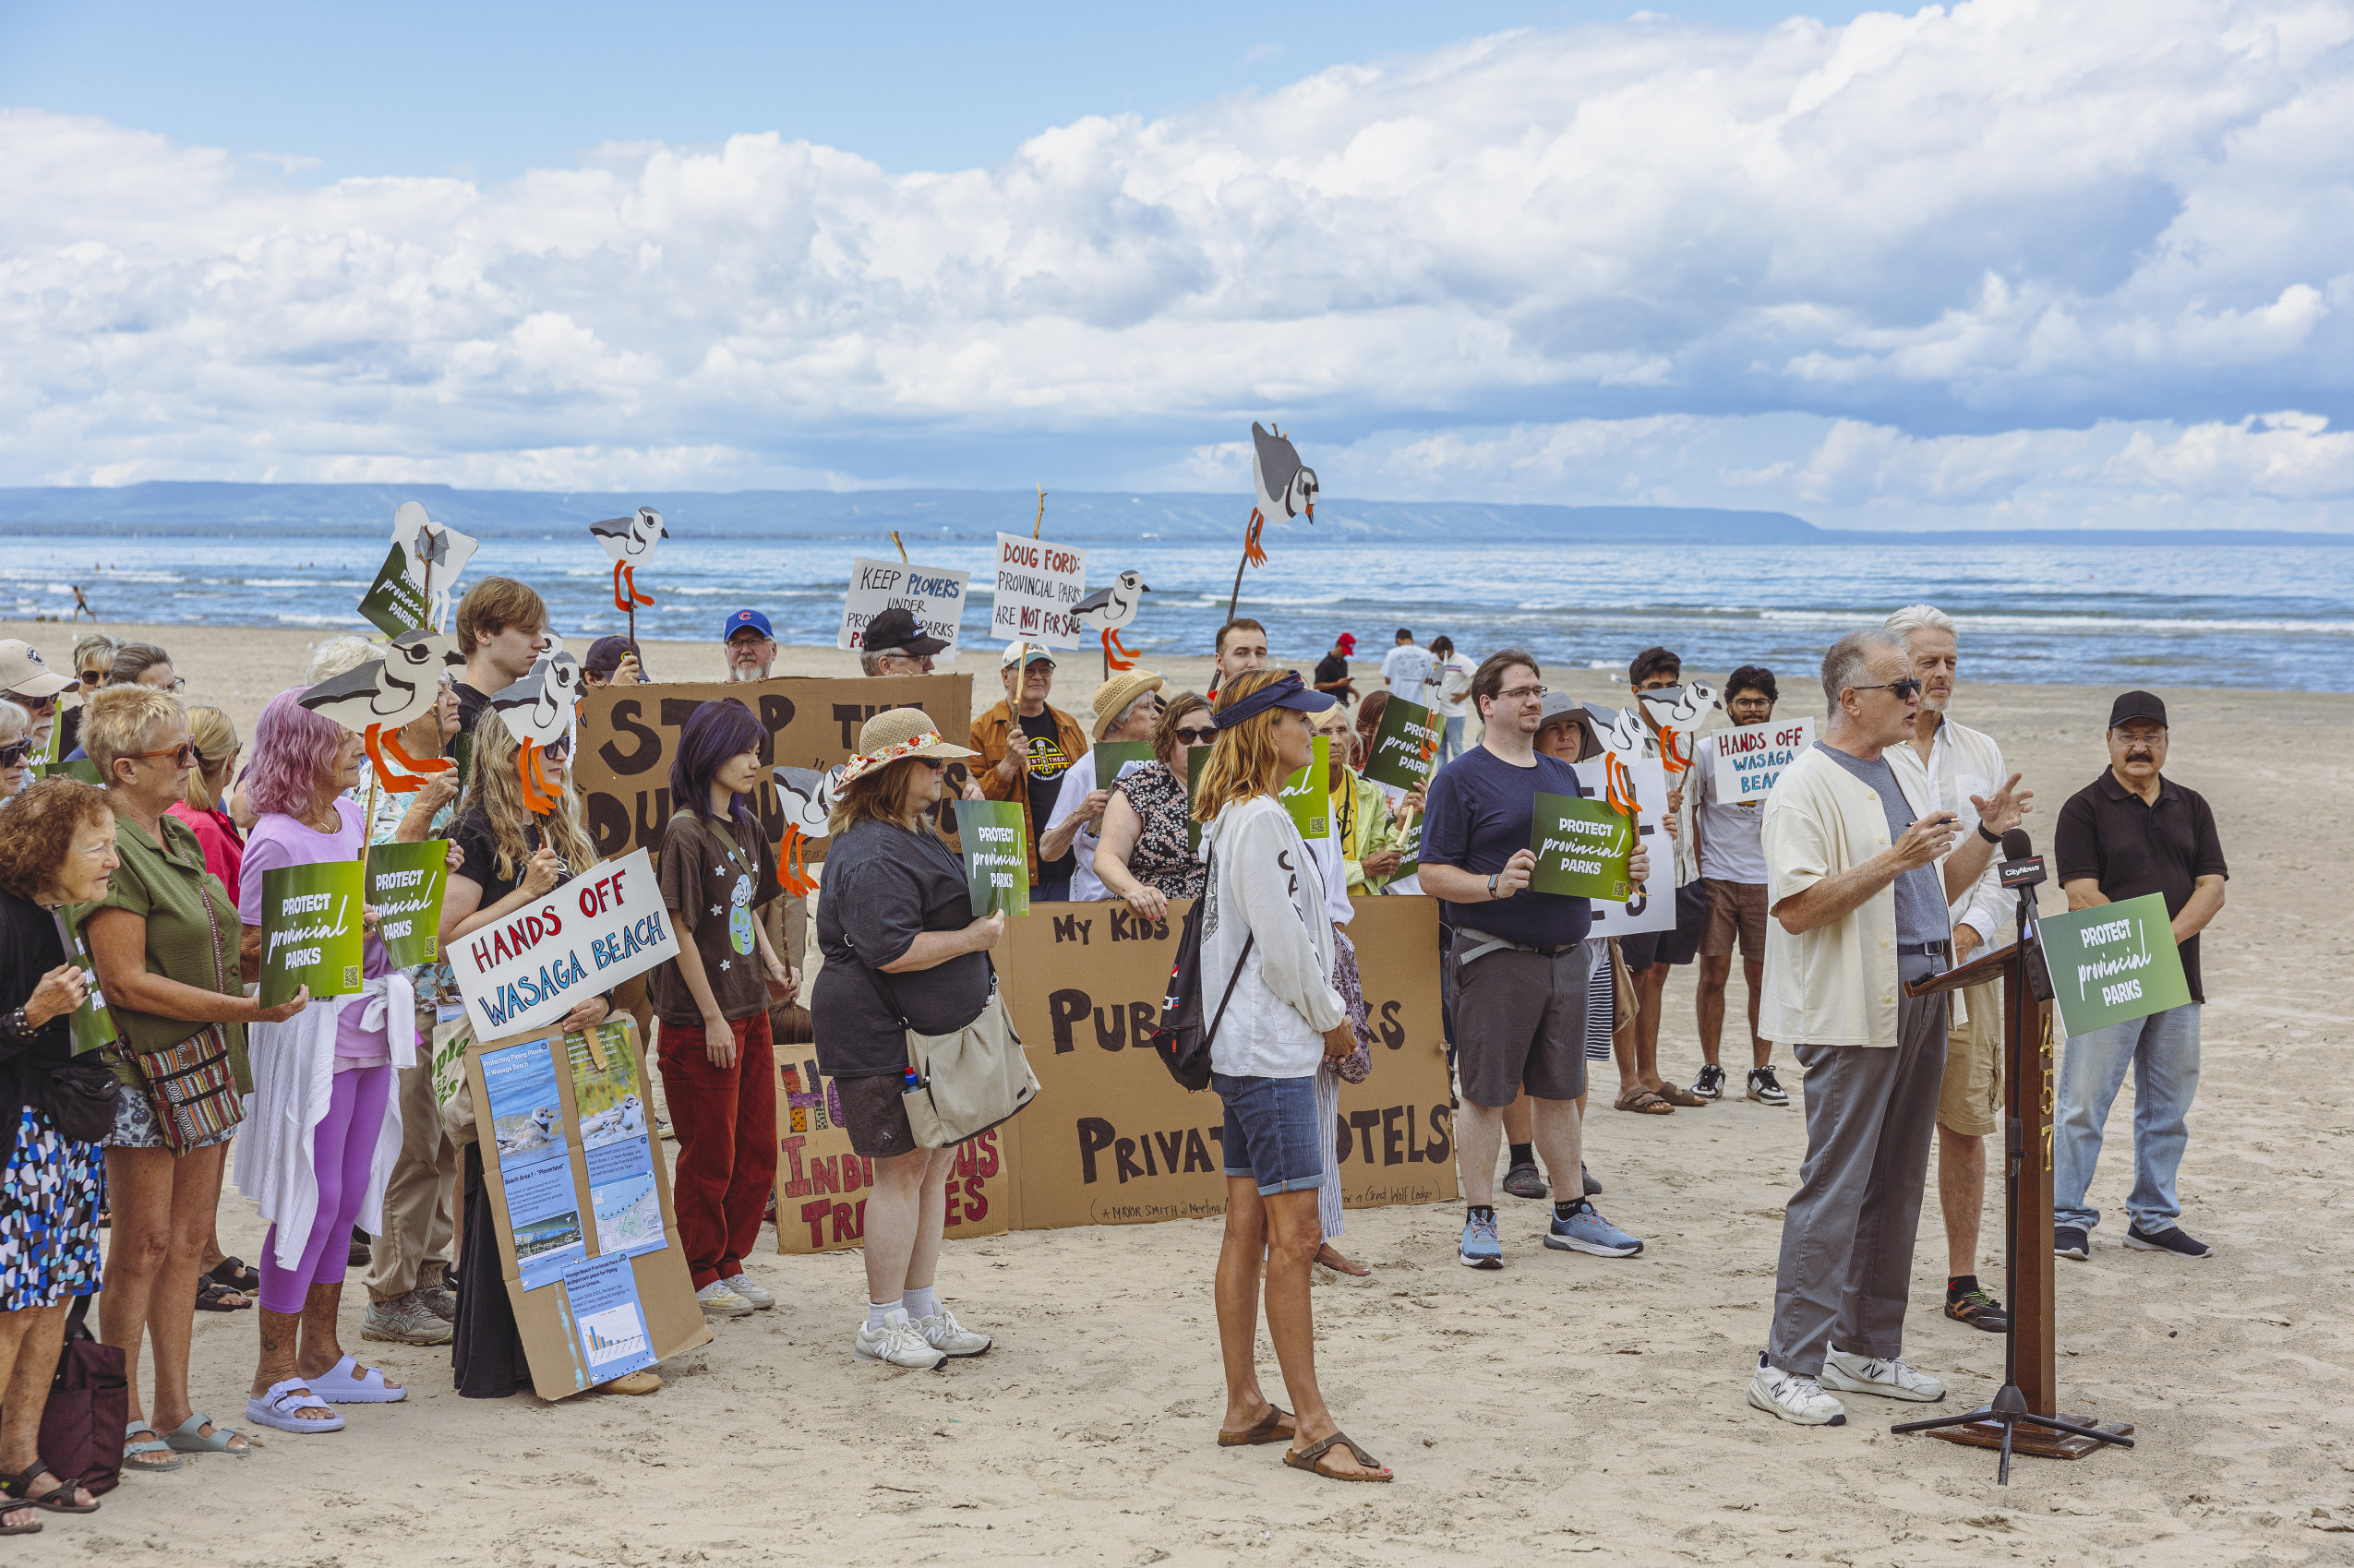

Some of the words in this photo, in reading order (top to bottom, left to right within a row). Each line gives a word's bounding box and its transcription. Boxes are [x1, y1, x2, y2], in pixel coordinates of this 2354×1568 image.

[1003, 543, 1039, 568] DOUG
[1045, 549, 1080, 574] FORD:
[860, 567, 901, 590] KEEP
[906, 573, 960, 598] PLOVERS
[998, 571, 1055, 598] PROVINCIAL
[1058, 582, 1082, 604] PARKS
[389, 601, 419, 629] PARKS
[739, 611, 751, 620] C
[887, 597, 926, 613] UNDER
[920, 619, 955, 638] PARKS
[995, 605, 1016, 625] ARE
[1020, 605, 1041, 629] NOT
[1043, 612, 1060, 633] FOR
[1061, 614, 1081, 637] SALE
[598, 694, 796, 776] STP
[1718, 732, 1767, 757] HANDS
[1775, 726, 1803, 747] OFF
[1732, 749, 1795, 772] WASAGA
[1740, 772, 1780, 794] BEAC
[978, 826, 1014, 843] PROTECT
[1558, 818, 1614, 838] PROTECT
[972, 831, 1023, 879] provincial
[1538, 828, 1627, 861] provincial
[1560, 857, 1602, 875] PARKS
[2004, 864, 2040, 877] CityNews
[375, 869, 425, 892] PROTECT
[990, 872, 1014, 888] PARKS
[282, 892, 332, 917] PROTECT
[267, 893, 349, 965] provincial
[383, 919, 413, 941] PARKS
[471, 905, 562, 974] HANDS
[579, 868, 626, 918] OFF
[1110, 907, 1171, 942] KIDS
[2080, 918, 2132, 949] PROTECT
[284, 947, 322, 971] PARKS
[477, 950, 589, 1027] WASAGA
[591, 911, 667, 971] BEACH
[2077, 918, 2152, 1002] provincial
[2101, 978, 2143, 1007] PARKS
[1048, 988, 1159, 1056] PUB
[483, 1056, 511, 1068] Protecting
[510, 1051, 528, 1061] Piping
[490, 1066, 512, 1077] Wasaga
[511, 1061, 529, 1071] Beach
[1076, 1117, 1225, 1185] PRIVAT
[1337, 1104, 1451, 1167] OTELS
[504, 1177, 520, 1186] Beach
[519, 1173, 531, 1181] Area
[1364, 1185, 1387, 1202] Great
[800, 1175, 990, 1249] TRIES
[1112, 1205, 1143, 1220] MAYOR
[1145, 1204, 1178, 1216] SMITH
[1189, 1198, 1221, 1215] Meeting
[564, 1270, 580, 1279] Wasaga
[579, 1266, 592, 1275] Beach
[590, 1261, 609, 1271] Provincial
[570, 1275, 590, 1285] important
[605, 1265, 619, 1275] Piping
[567, 1284, 582, 1293] Plovers
